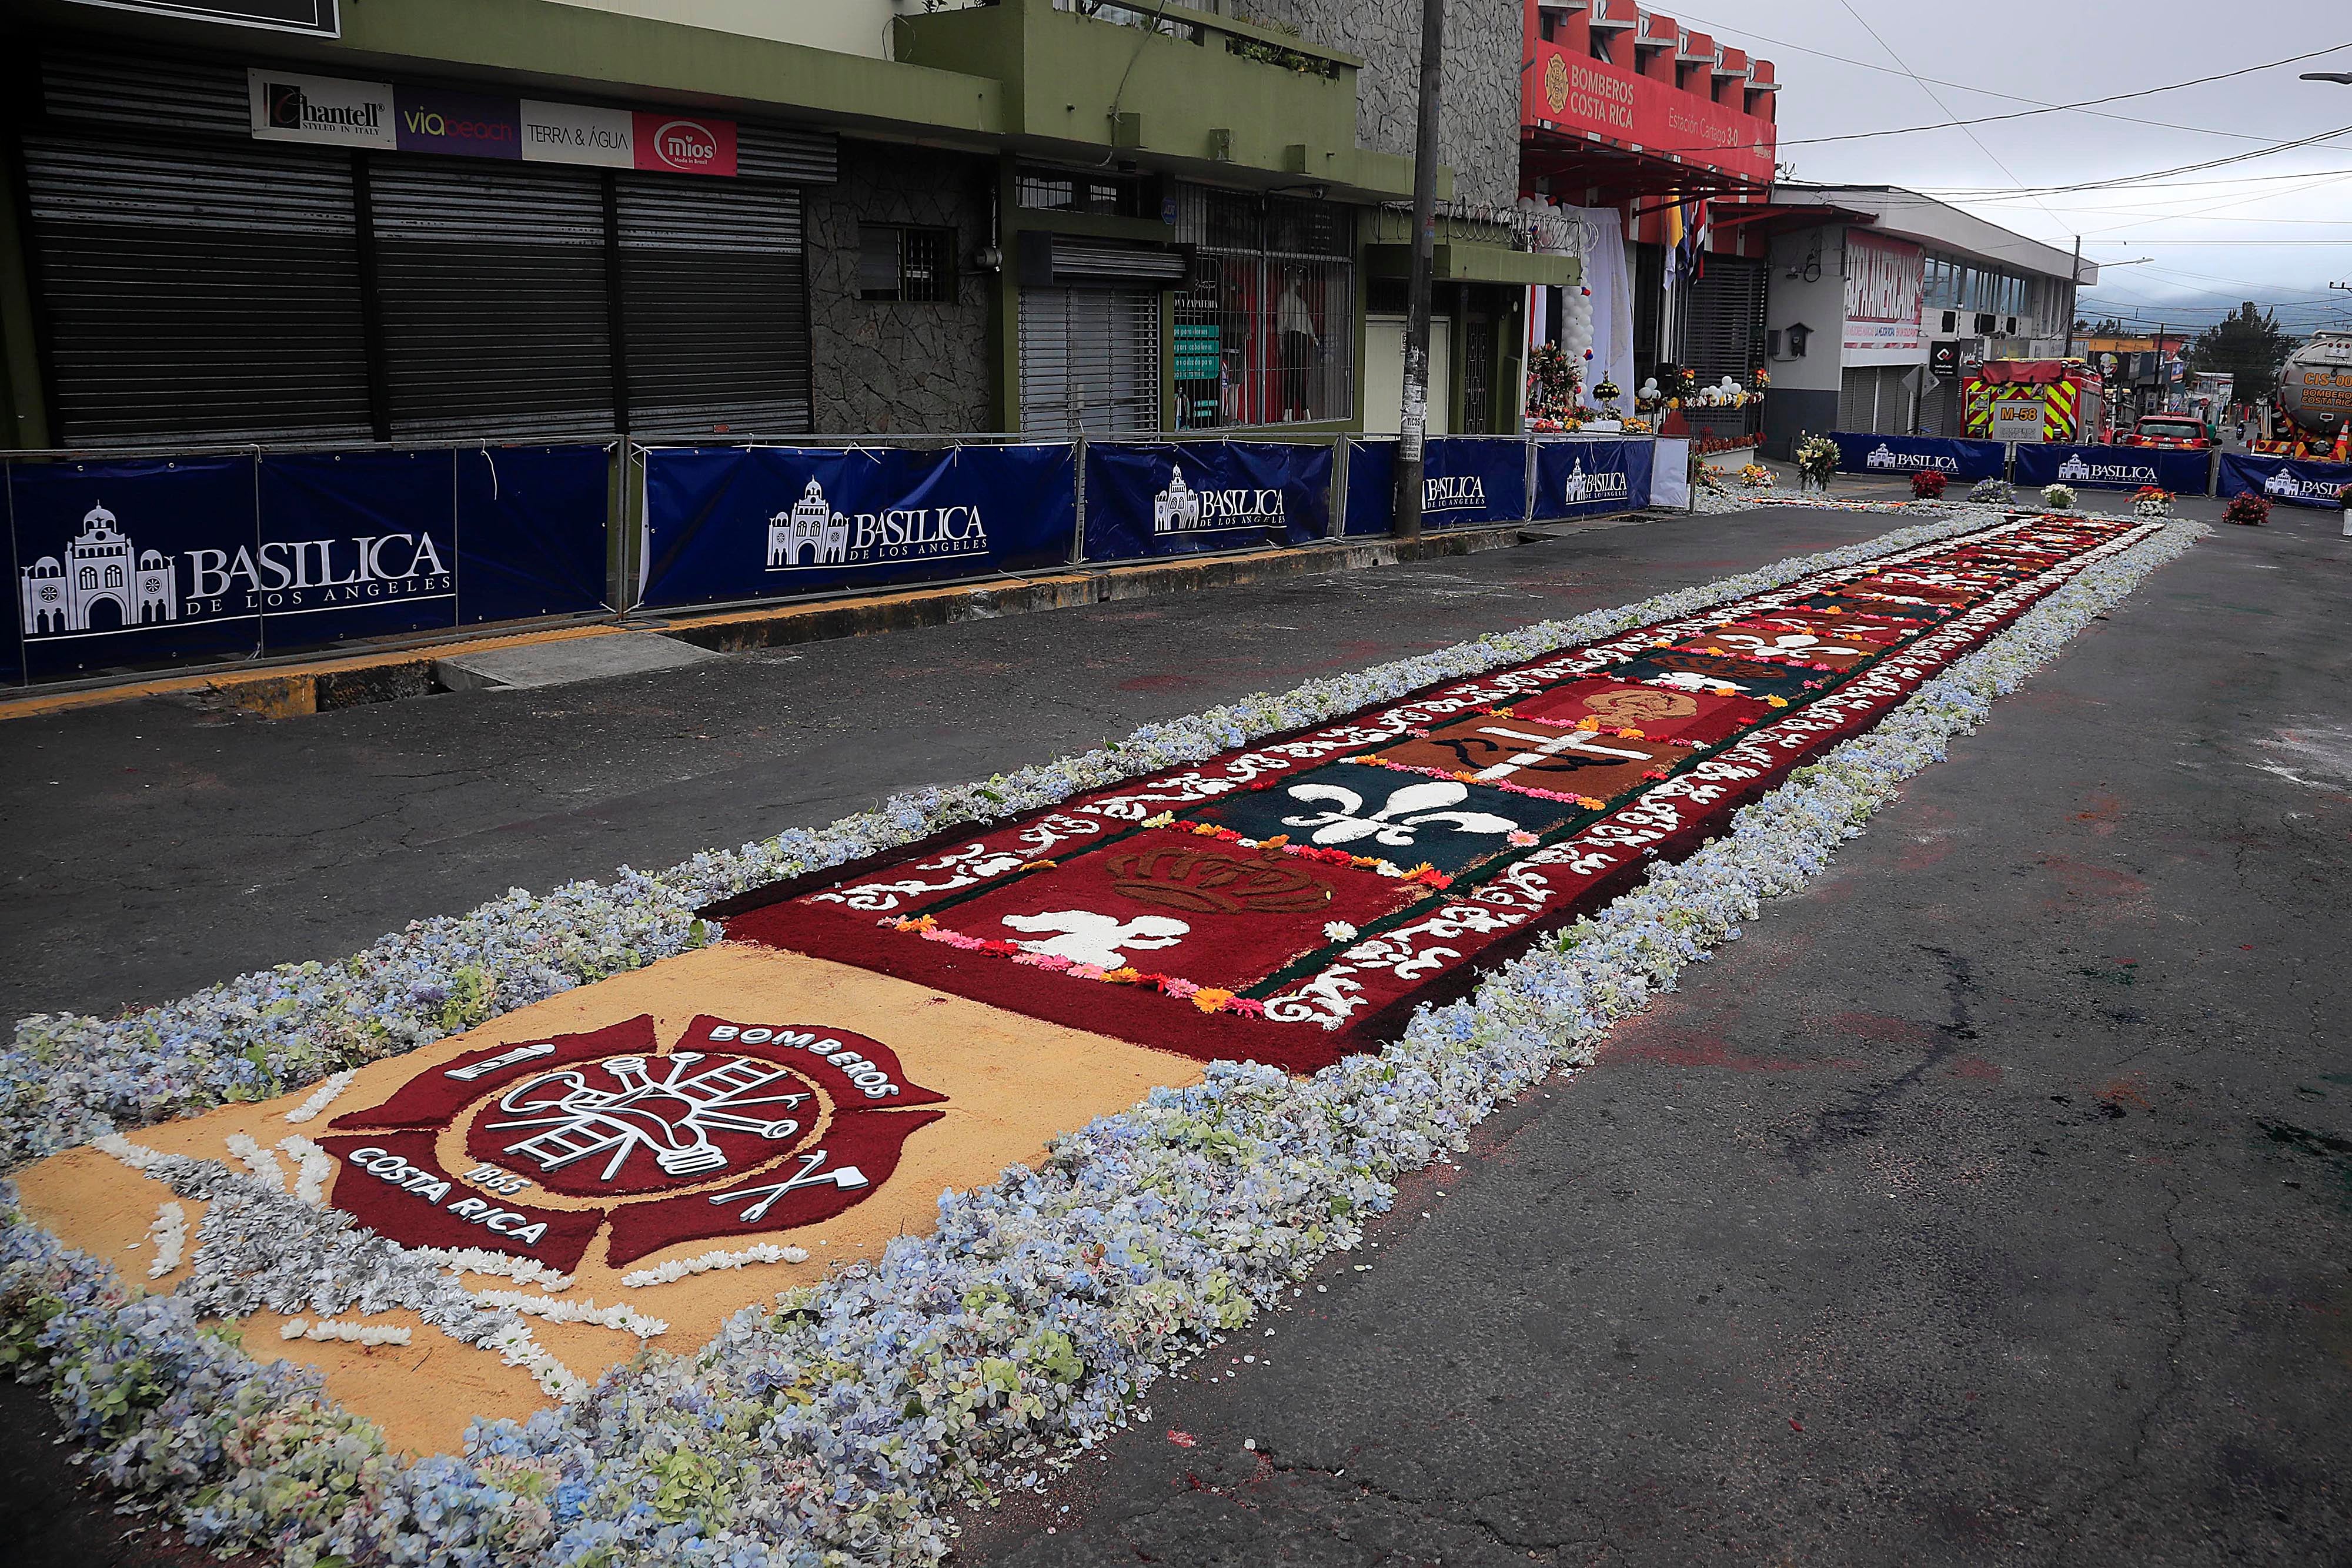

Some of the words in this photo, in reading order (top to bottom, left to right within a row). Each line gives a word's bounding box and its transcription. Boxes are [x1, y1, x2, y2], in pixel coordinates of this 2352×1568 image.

[1572, 64, 1634, 105] BOMBEROS
[1571, 91, 1606, 122] COSTA
[1609, 103, 1633, 130] RICA
[302, 122, 336, 132] STYLED
[355, 126, 379, 135] ITALY
[527, 124, 572, 145] TERRA
[574, 128, 585, 146] &
[589, 126, 629, 150] ÁGUA
[1669, 107, 1698, 135] Estación
[1700, 118, 1726, 148] Cartago
[1727, 126, 1738, 147] 3-0
[2000, 407, 2037, 421] M-58
[2301, 396, 2333, 406] COSTA
[2335, 398, 2352, 407] RIC
[1897, 453, 1959, 469] BASILICA
[2091, 464, 2157, 479] BASILICA
[1585, 472, 1627, 493] BASILICA
[1200, 489, 1285, 519] BASILICA
[851, 504, 987, 550] BASILICA
[1200, 519, 1211, 527] DE
[1218, 517, 1235, 526] LOS
[1241, 515, 1285, 524] ANGELES
[849, 549, 870, 561] DE
[879, 546, 908, 558] LOS
[918, 538, 987, 554] ANGELES
[184, 530, 450, 600] BASILICA
[186, 599, 222, 616] DE
[245, 591, 302, 609] LOS
[323, 576, 450, 601] ANGELES
[709, 1025, 900, 1098] BOMBEROS
[463, 1162, 532, 1195] 1865
[348, 1147, 452, 1205] COSTA
[446, 1197, 548, 1248] RICA
